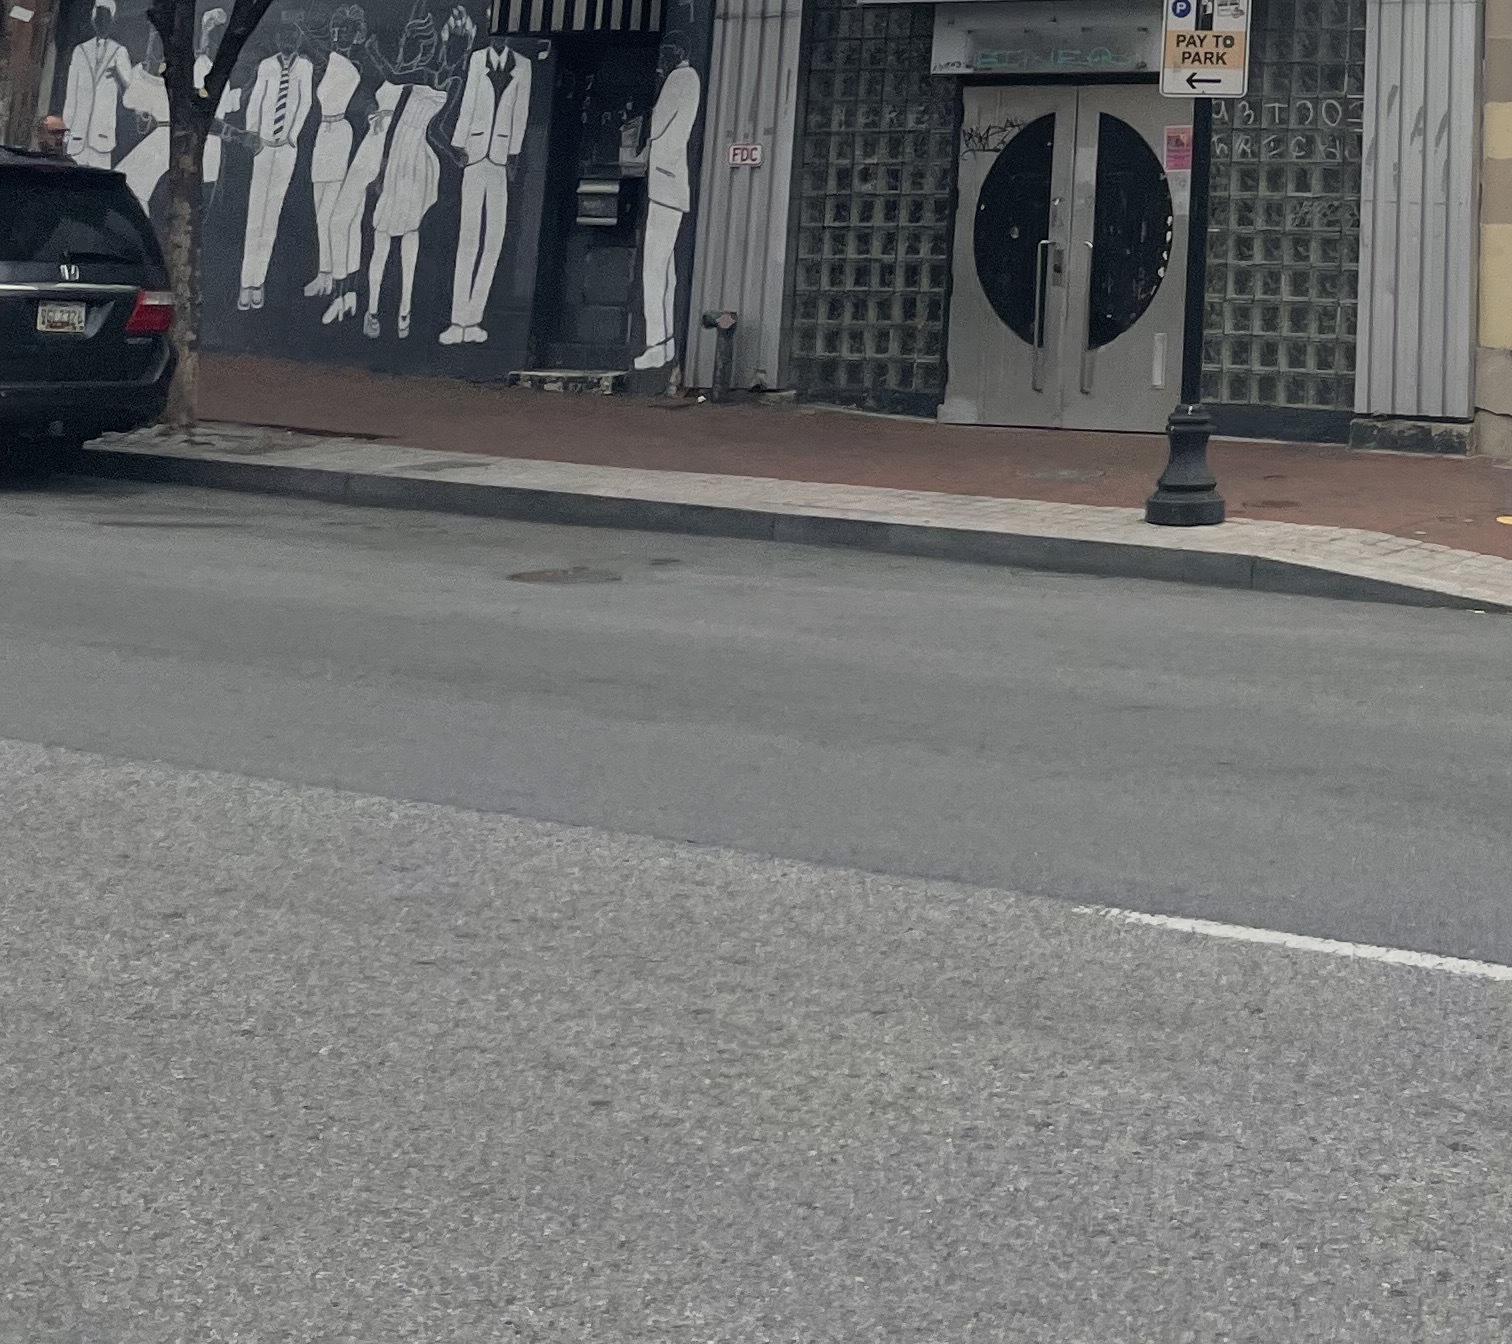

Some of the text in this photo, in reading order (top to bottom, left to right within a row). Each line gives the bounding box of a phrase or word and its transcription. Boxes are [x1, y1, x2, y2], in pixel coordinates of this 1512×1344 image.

[1176, 34, 1235, 48] PAY TO
[1182, 51, 1227, 65] PARK
[732, 147, 758, 162] FDC
